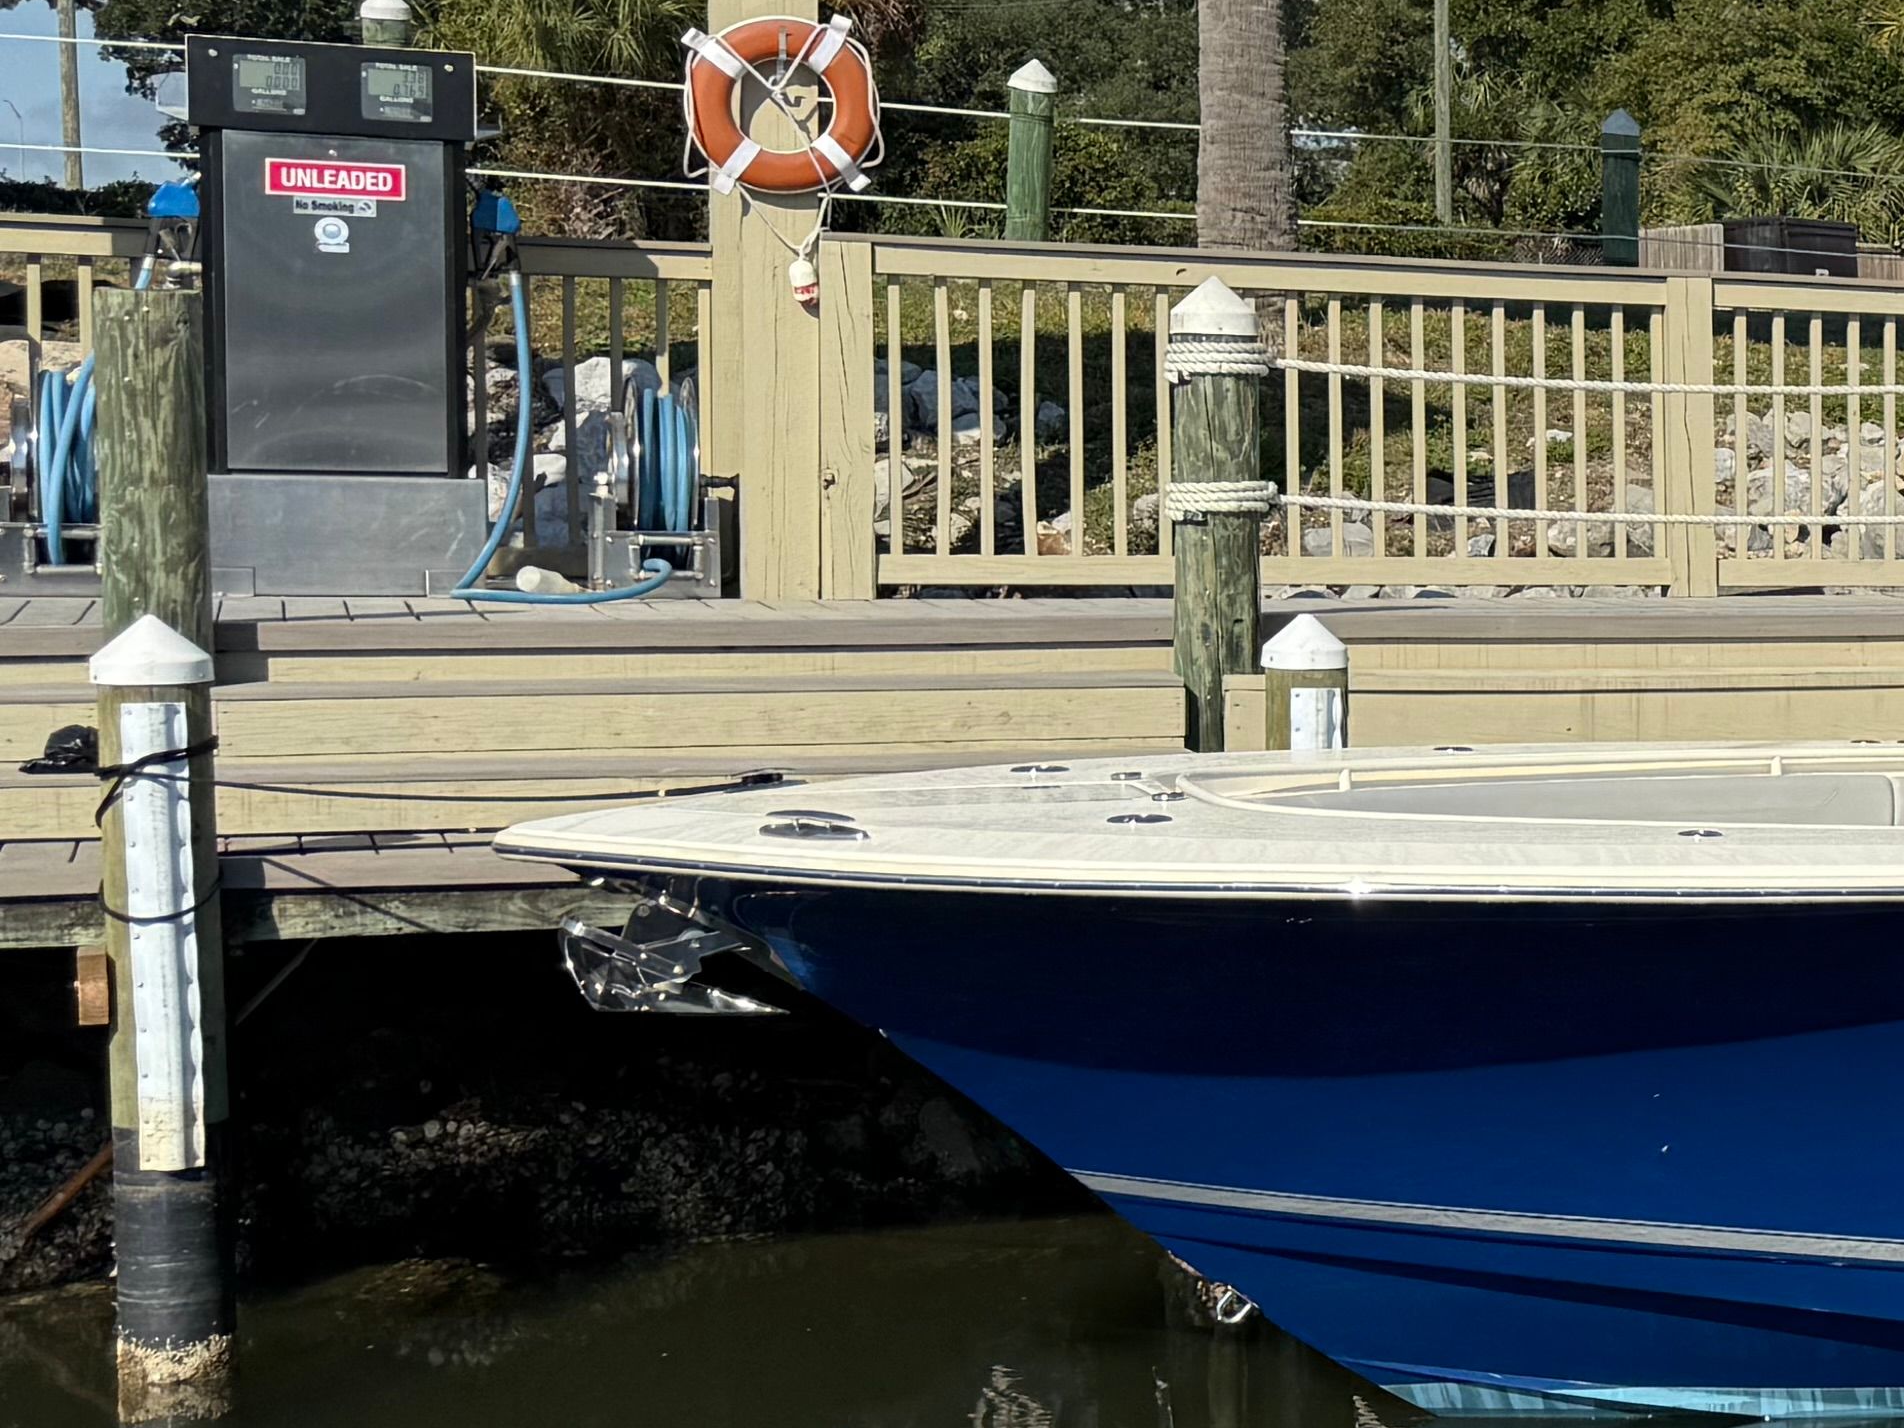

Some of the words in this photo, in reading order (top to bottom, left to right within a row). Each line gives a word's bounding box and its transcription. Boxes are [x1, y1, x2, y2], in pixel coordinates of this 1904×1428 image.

[280, 166, 393, 192] UNLEADED
[295, 199, 309, 210] No
[311, 199, 355, 214] Smoking
